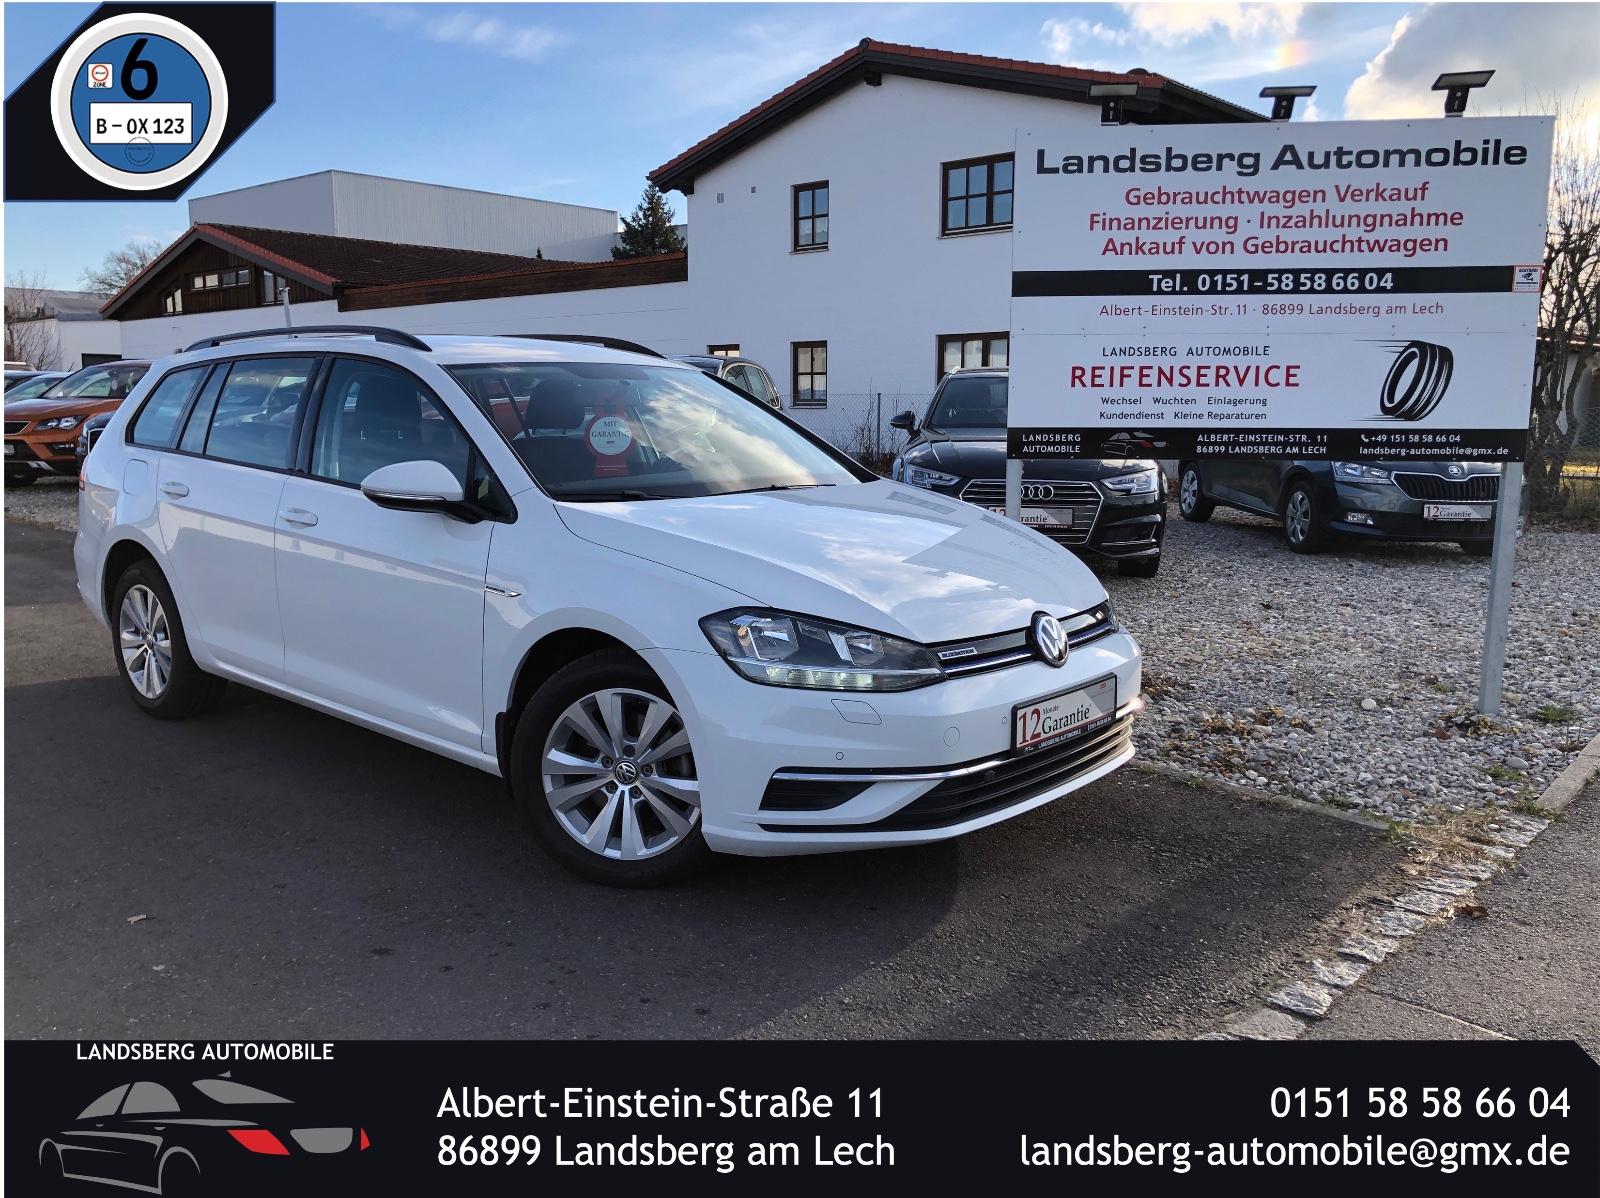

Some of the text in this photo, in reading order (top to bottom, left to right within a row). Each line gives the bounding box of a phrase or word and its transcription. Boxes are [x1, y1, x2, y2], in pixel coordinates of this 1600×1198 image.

[1037, 138, 1527, 177] Landsberg Automobile
[1125, 181, 1430, 209] Gebrauchtwagen Verkauf
[1090, 207, 1463, 235] Finanzierung Inzahlungnahme
[1101, 234, 1448, 257] Ankauf von Gebrauchtwagen
[1149, 273, 1188, 291] Tel.
[1099, 301, 1443, 318] Albert-Einstein-Str. 11 86899 Landsberg am Lech
[1102, 345, 1270, 357] LANDSBERG AUTOMOBILE
[1071, 365, 1300, 388] REIFENSERVICE
[1101, 396, 1267, 407] Wechsel Wuchten Einlagerung
[1100, 411, 1267, 421] Kundendienst Kleine Reparaturen
[1023, 434, 1081, 442] LANDSBERG
[1197, 434, 1311, 442] ALBERT-EINSTEIN-STR.
[1371, 434, 1387, 442] +49
[1391, 434, 1405, 442] 151
[1409, 434, 1419, 442] 58
[1422, 434, 1433, 442] 58
[1435, 434, 1447, 442] 66
[1449, 434, 1460, 442] 04
[1023, 445, 1509, 456] AUTOMOBILE 86899 LANDSBERG AM LECH landsberg-automobile@gmx.de
[1425, 505, 1440, 518] 12
[1019, 707, 1041, 745] 12
[1041, 704, 1090, 735] Garantie
